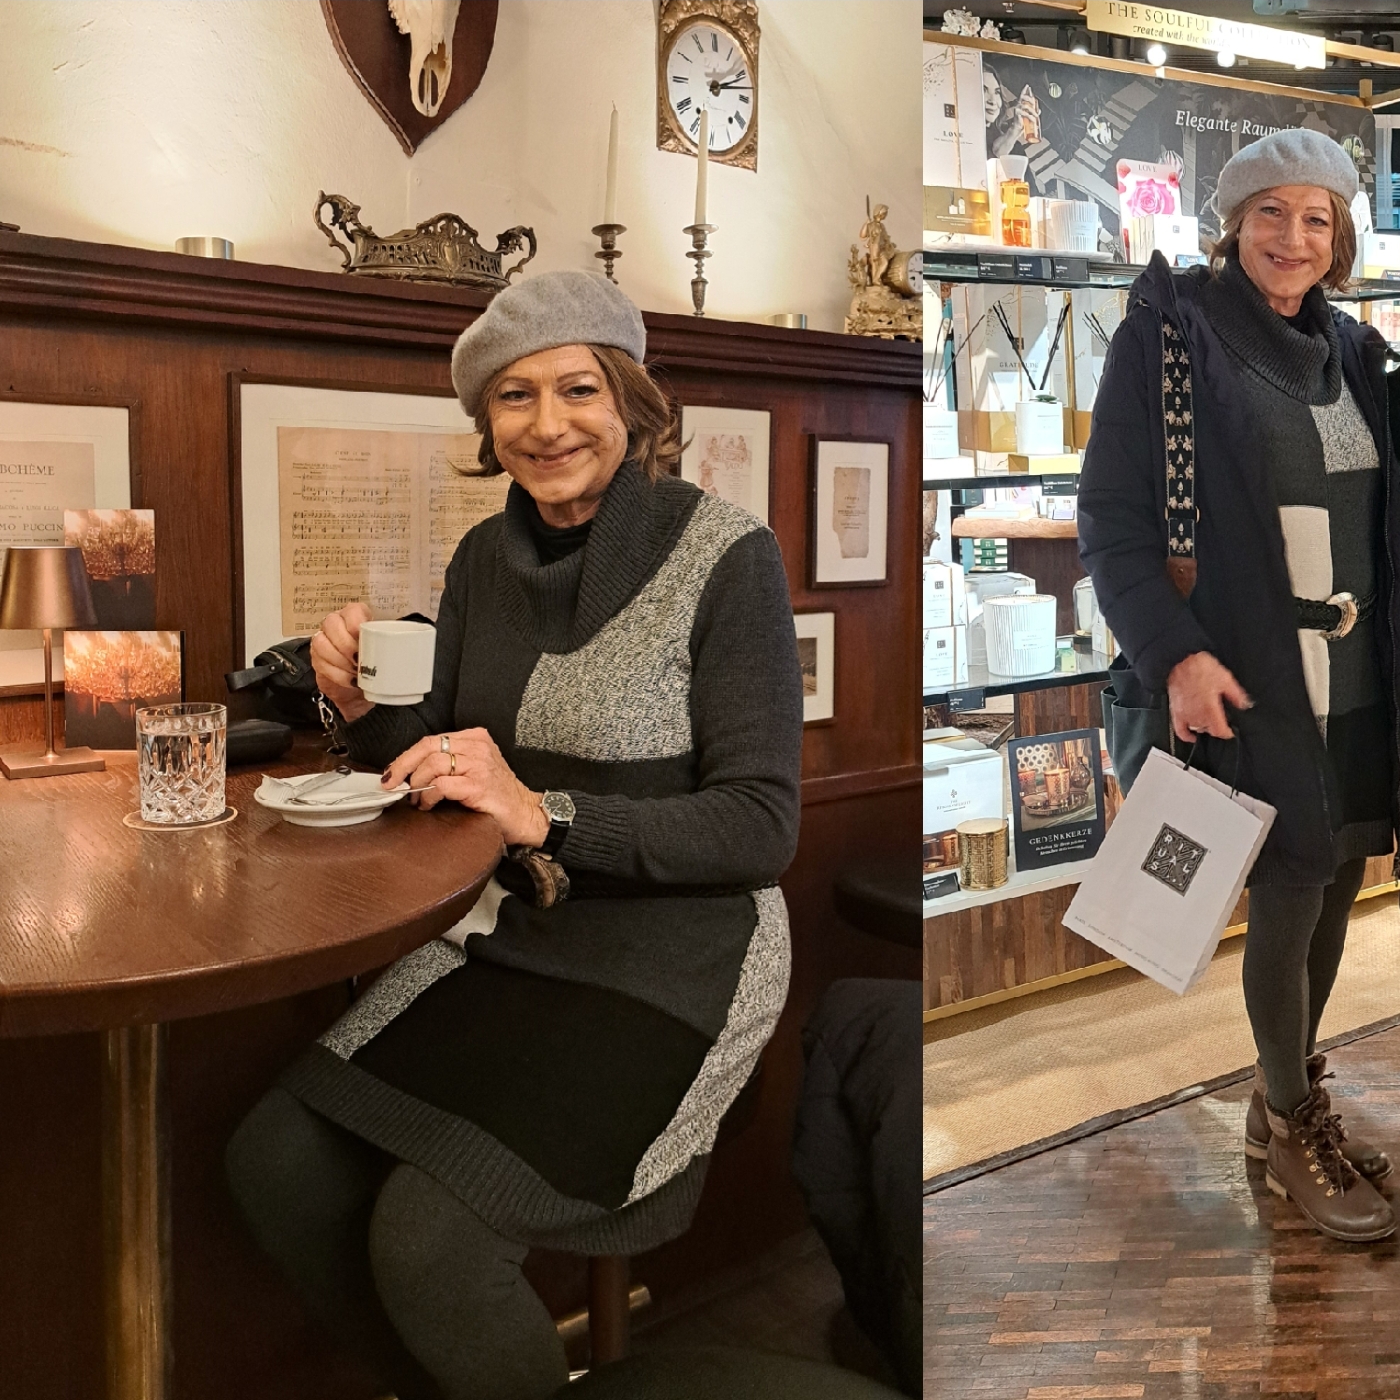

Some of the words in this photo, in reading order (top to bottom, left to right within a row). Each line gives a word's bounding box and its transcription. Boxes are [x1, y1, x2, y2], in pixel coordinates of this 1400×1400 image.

[1105, 1, 1139, 20] THE
[1144, 10, 1213, 33] SOULFUL
[1132, 25, 1164, 38] created
[1166, 29, 1184, 41] with
[1187, 31, 1200, 44] the
[1175, 110, 1238, 133] Elegante
[23, 522, 64, 531] PUCCIN
